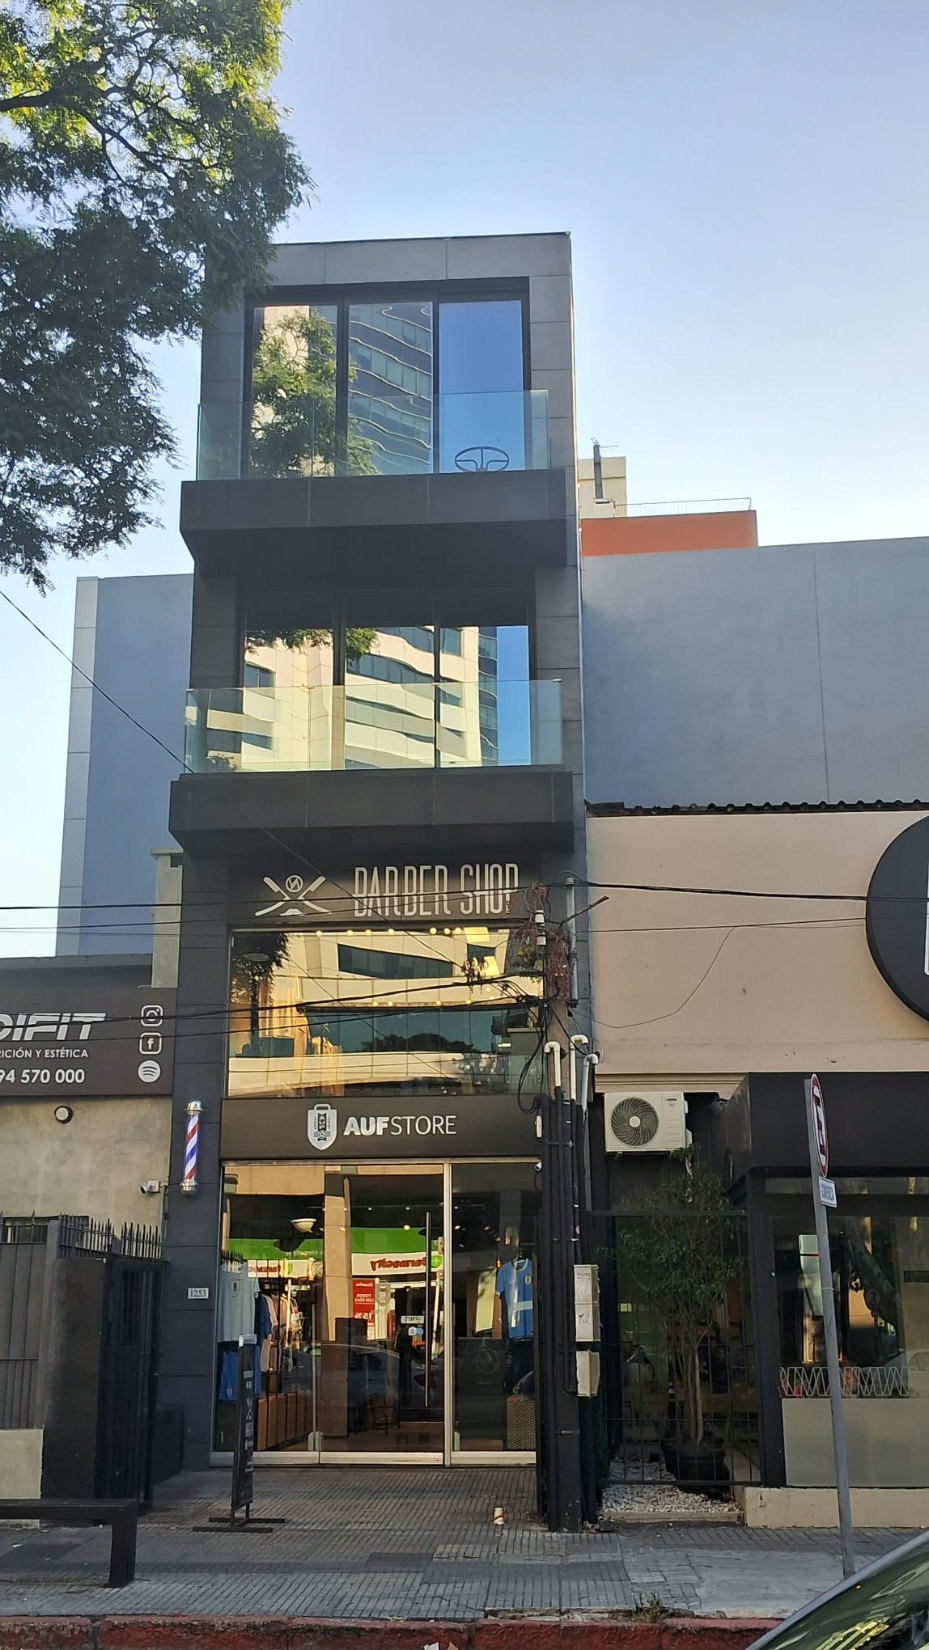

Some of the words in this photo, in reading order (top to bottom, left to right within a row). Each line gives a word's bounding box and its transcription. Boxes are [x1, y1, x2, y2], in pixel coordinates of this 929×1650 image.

[354, 865, 451, 917] BARBER
[460, 863, 519, 915] SHOP
[0, 1047, 32, 1059] ICIÓN
[35, 1049, 41, 1058] Y
[44, 1047, 89, 1059] ESTÉTICA
[20, 1069, 50, 1084] 570
[55, 1069, 85, 1084] 000
[343, 1115, 457, 1136] AUFSTORE
[190, 1289, 206, 1297] 1253
